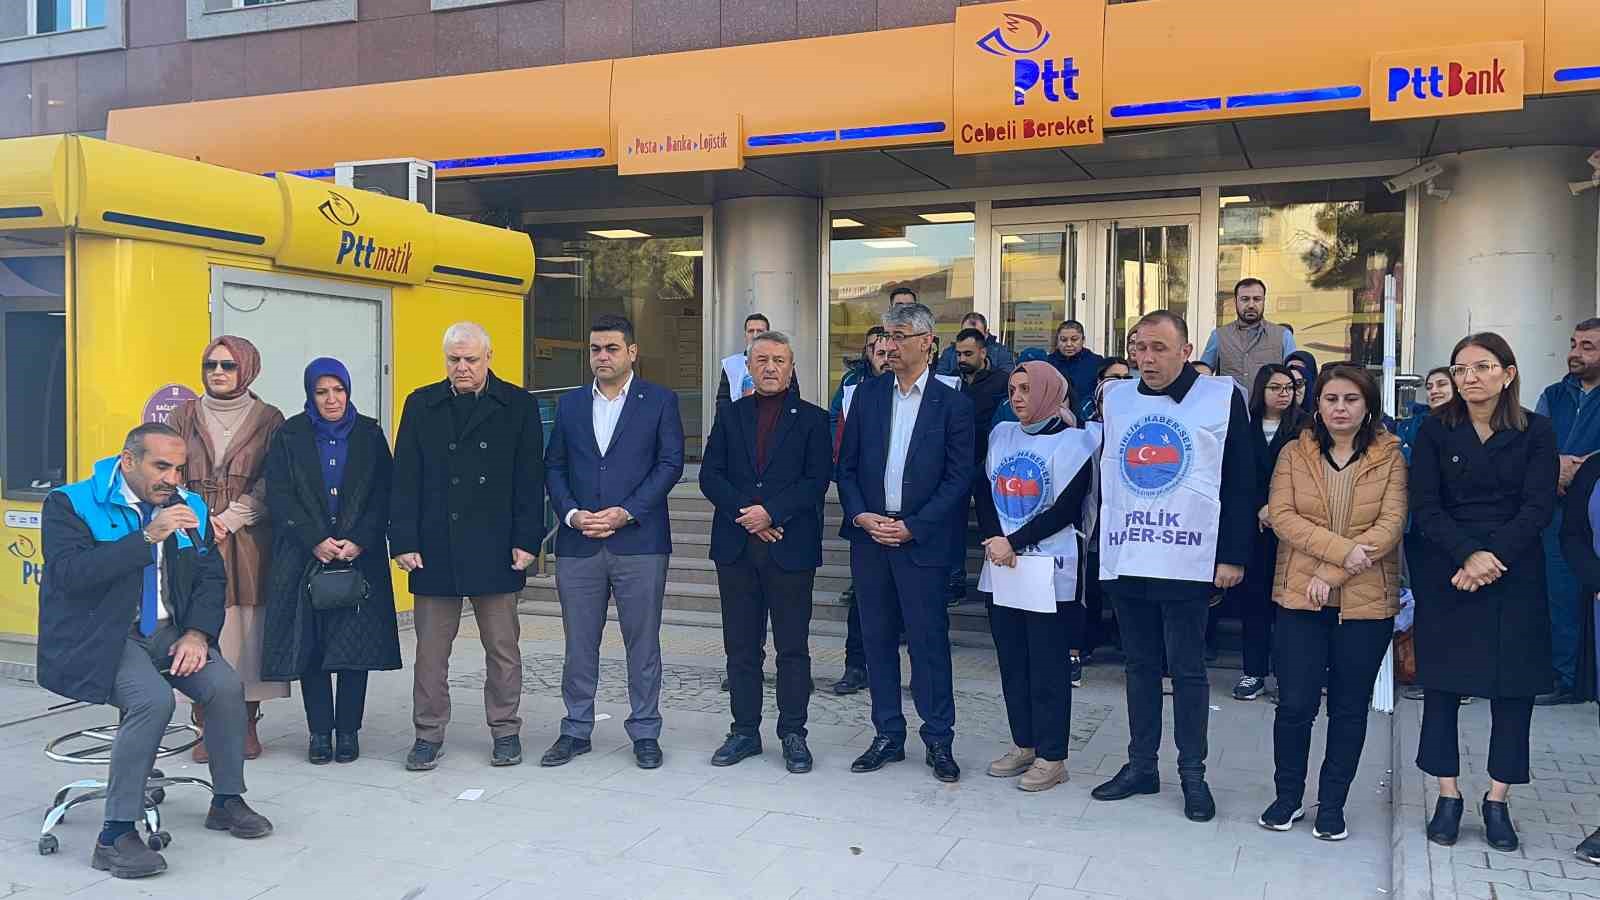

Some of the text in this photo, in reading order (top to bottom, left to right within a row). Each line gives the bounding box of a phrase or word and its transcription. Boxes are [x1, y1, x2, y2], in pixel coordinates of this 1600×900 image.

[1014, 57, 1080, 106] Ptt
[1388, 58, 1506, 102] PttBank
[635, 131, 728, 154] Posta Banka Lojistik
[961, 115, 1094, 143] Cebeli Bereket
[336, 230, 412, 274] Pttmatik
[23, 560, 42, 585] Pt
